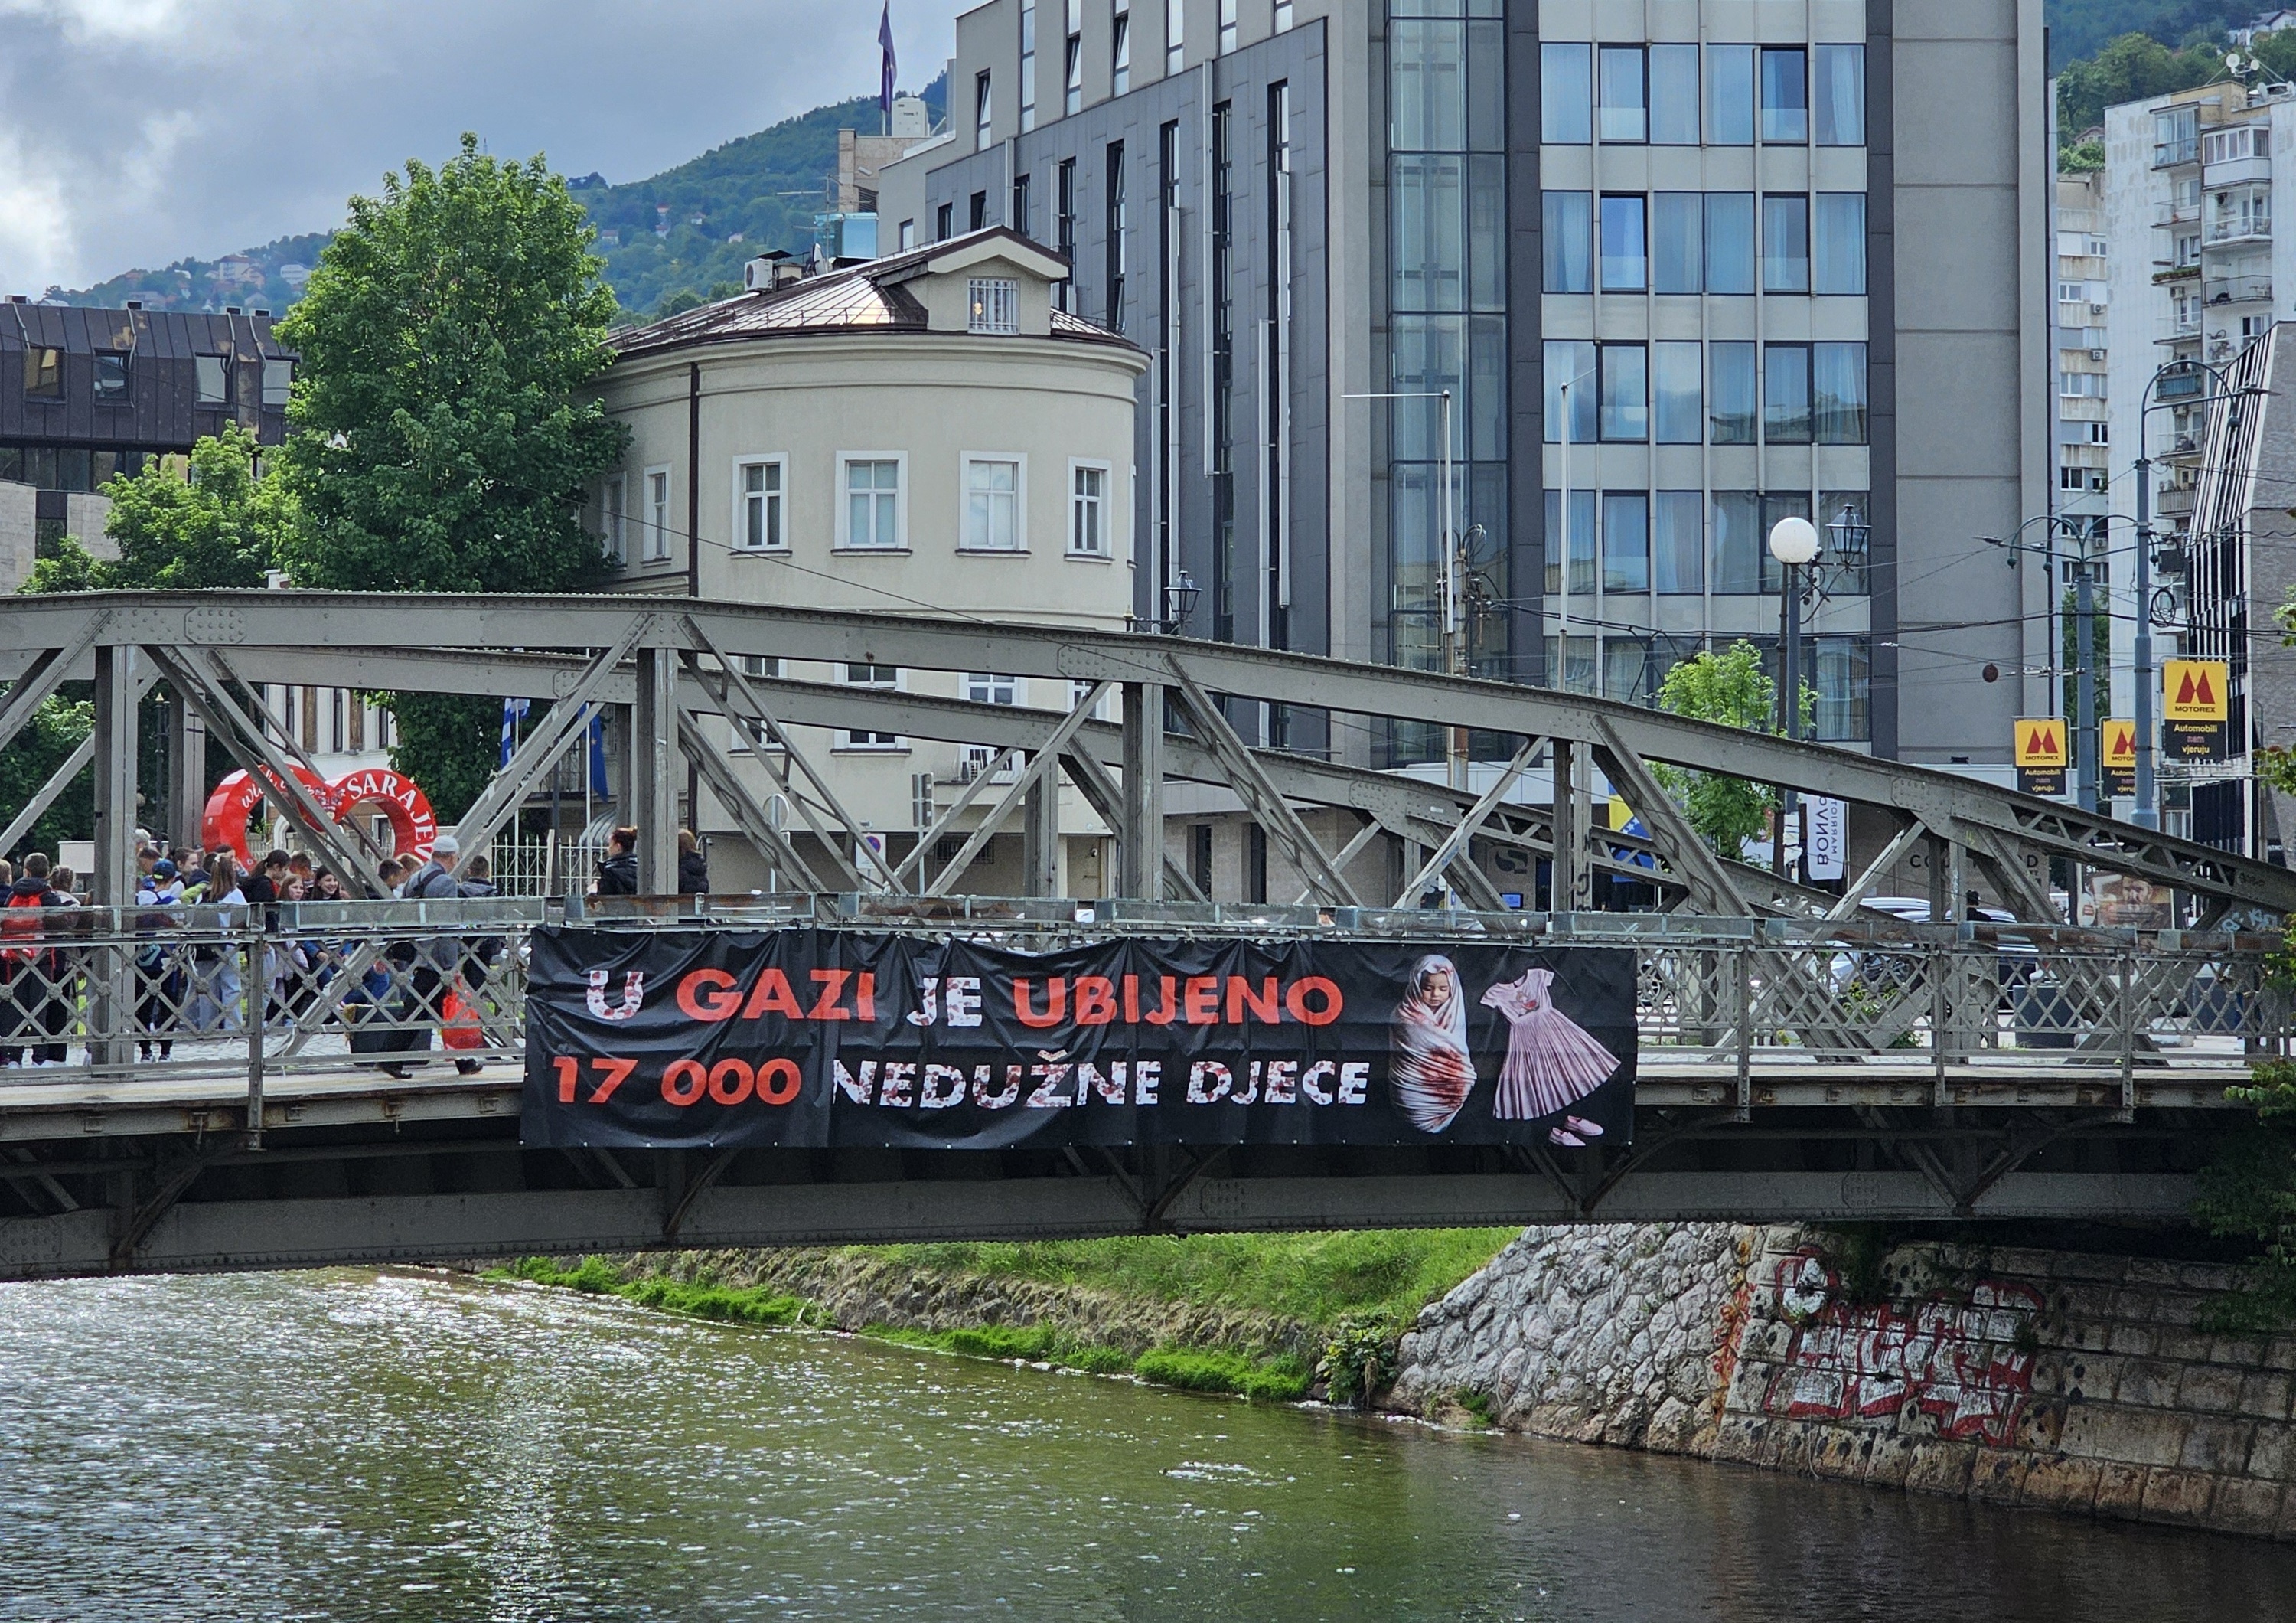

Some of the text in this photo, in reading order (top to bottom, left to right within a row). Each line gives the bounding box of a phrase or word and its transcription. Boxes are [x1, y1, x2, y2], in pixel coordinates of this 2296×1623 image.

[2174, 724, 2218, 733] Automobili
[2182, 745, 2210, 755] vjeruju
[347, 772, 434, 860] SARAJEV
[586, 968, 1344, 1027] U GAZI JE UBIJENO
[552, 1049, 1371, 1109] 17 000 NEDUŽNE DJECE
